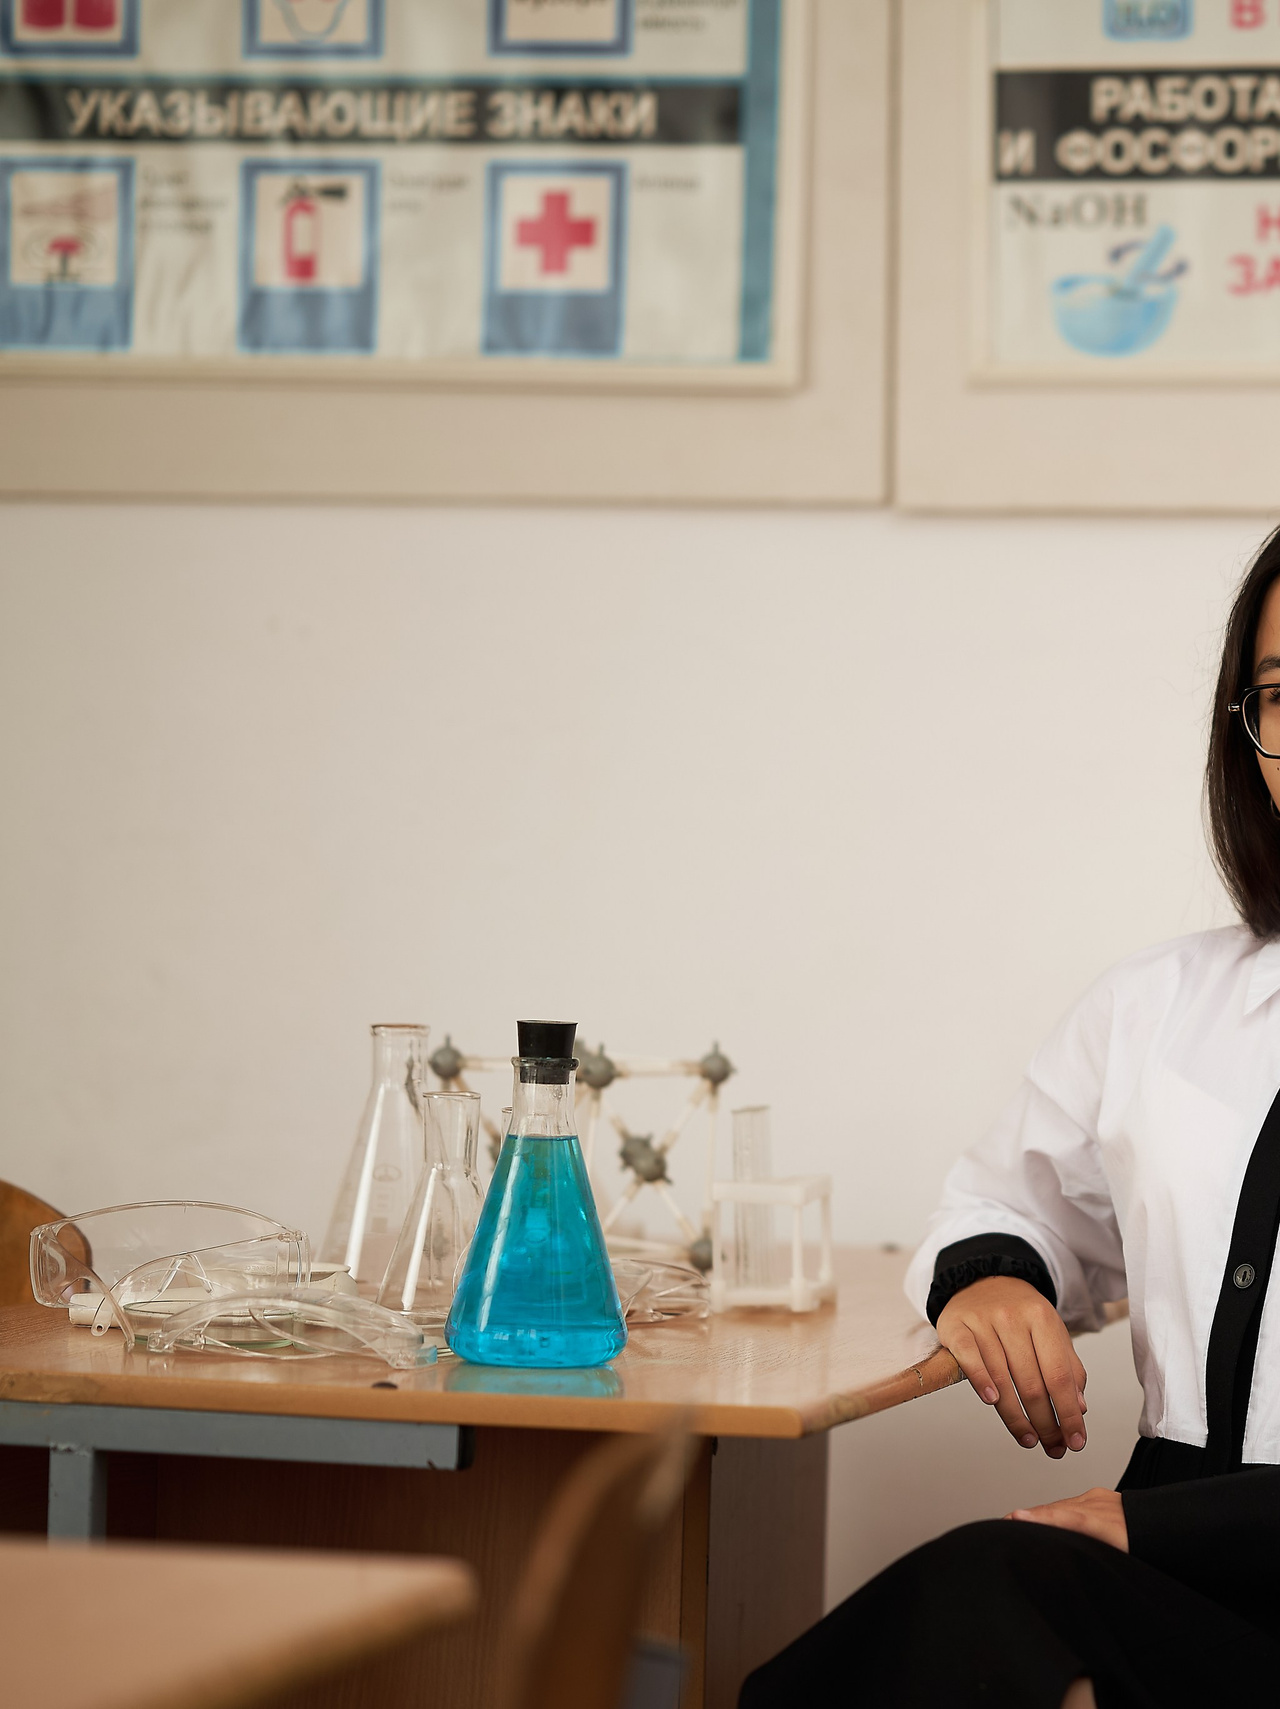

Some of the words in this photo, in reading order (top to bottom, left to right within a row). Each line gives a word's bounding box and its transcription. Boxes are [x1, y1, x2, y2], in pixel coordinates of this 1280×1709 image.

[67, 90, 475, 140] УКАЗЫВАЮЩИЕ
[485, 92, 658, 138] ЗНАКИ
[999, 130, 1035, 175] И
[1006, 193, 1148, 232] NaOH
